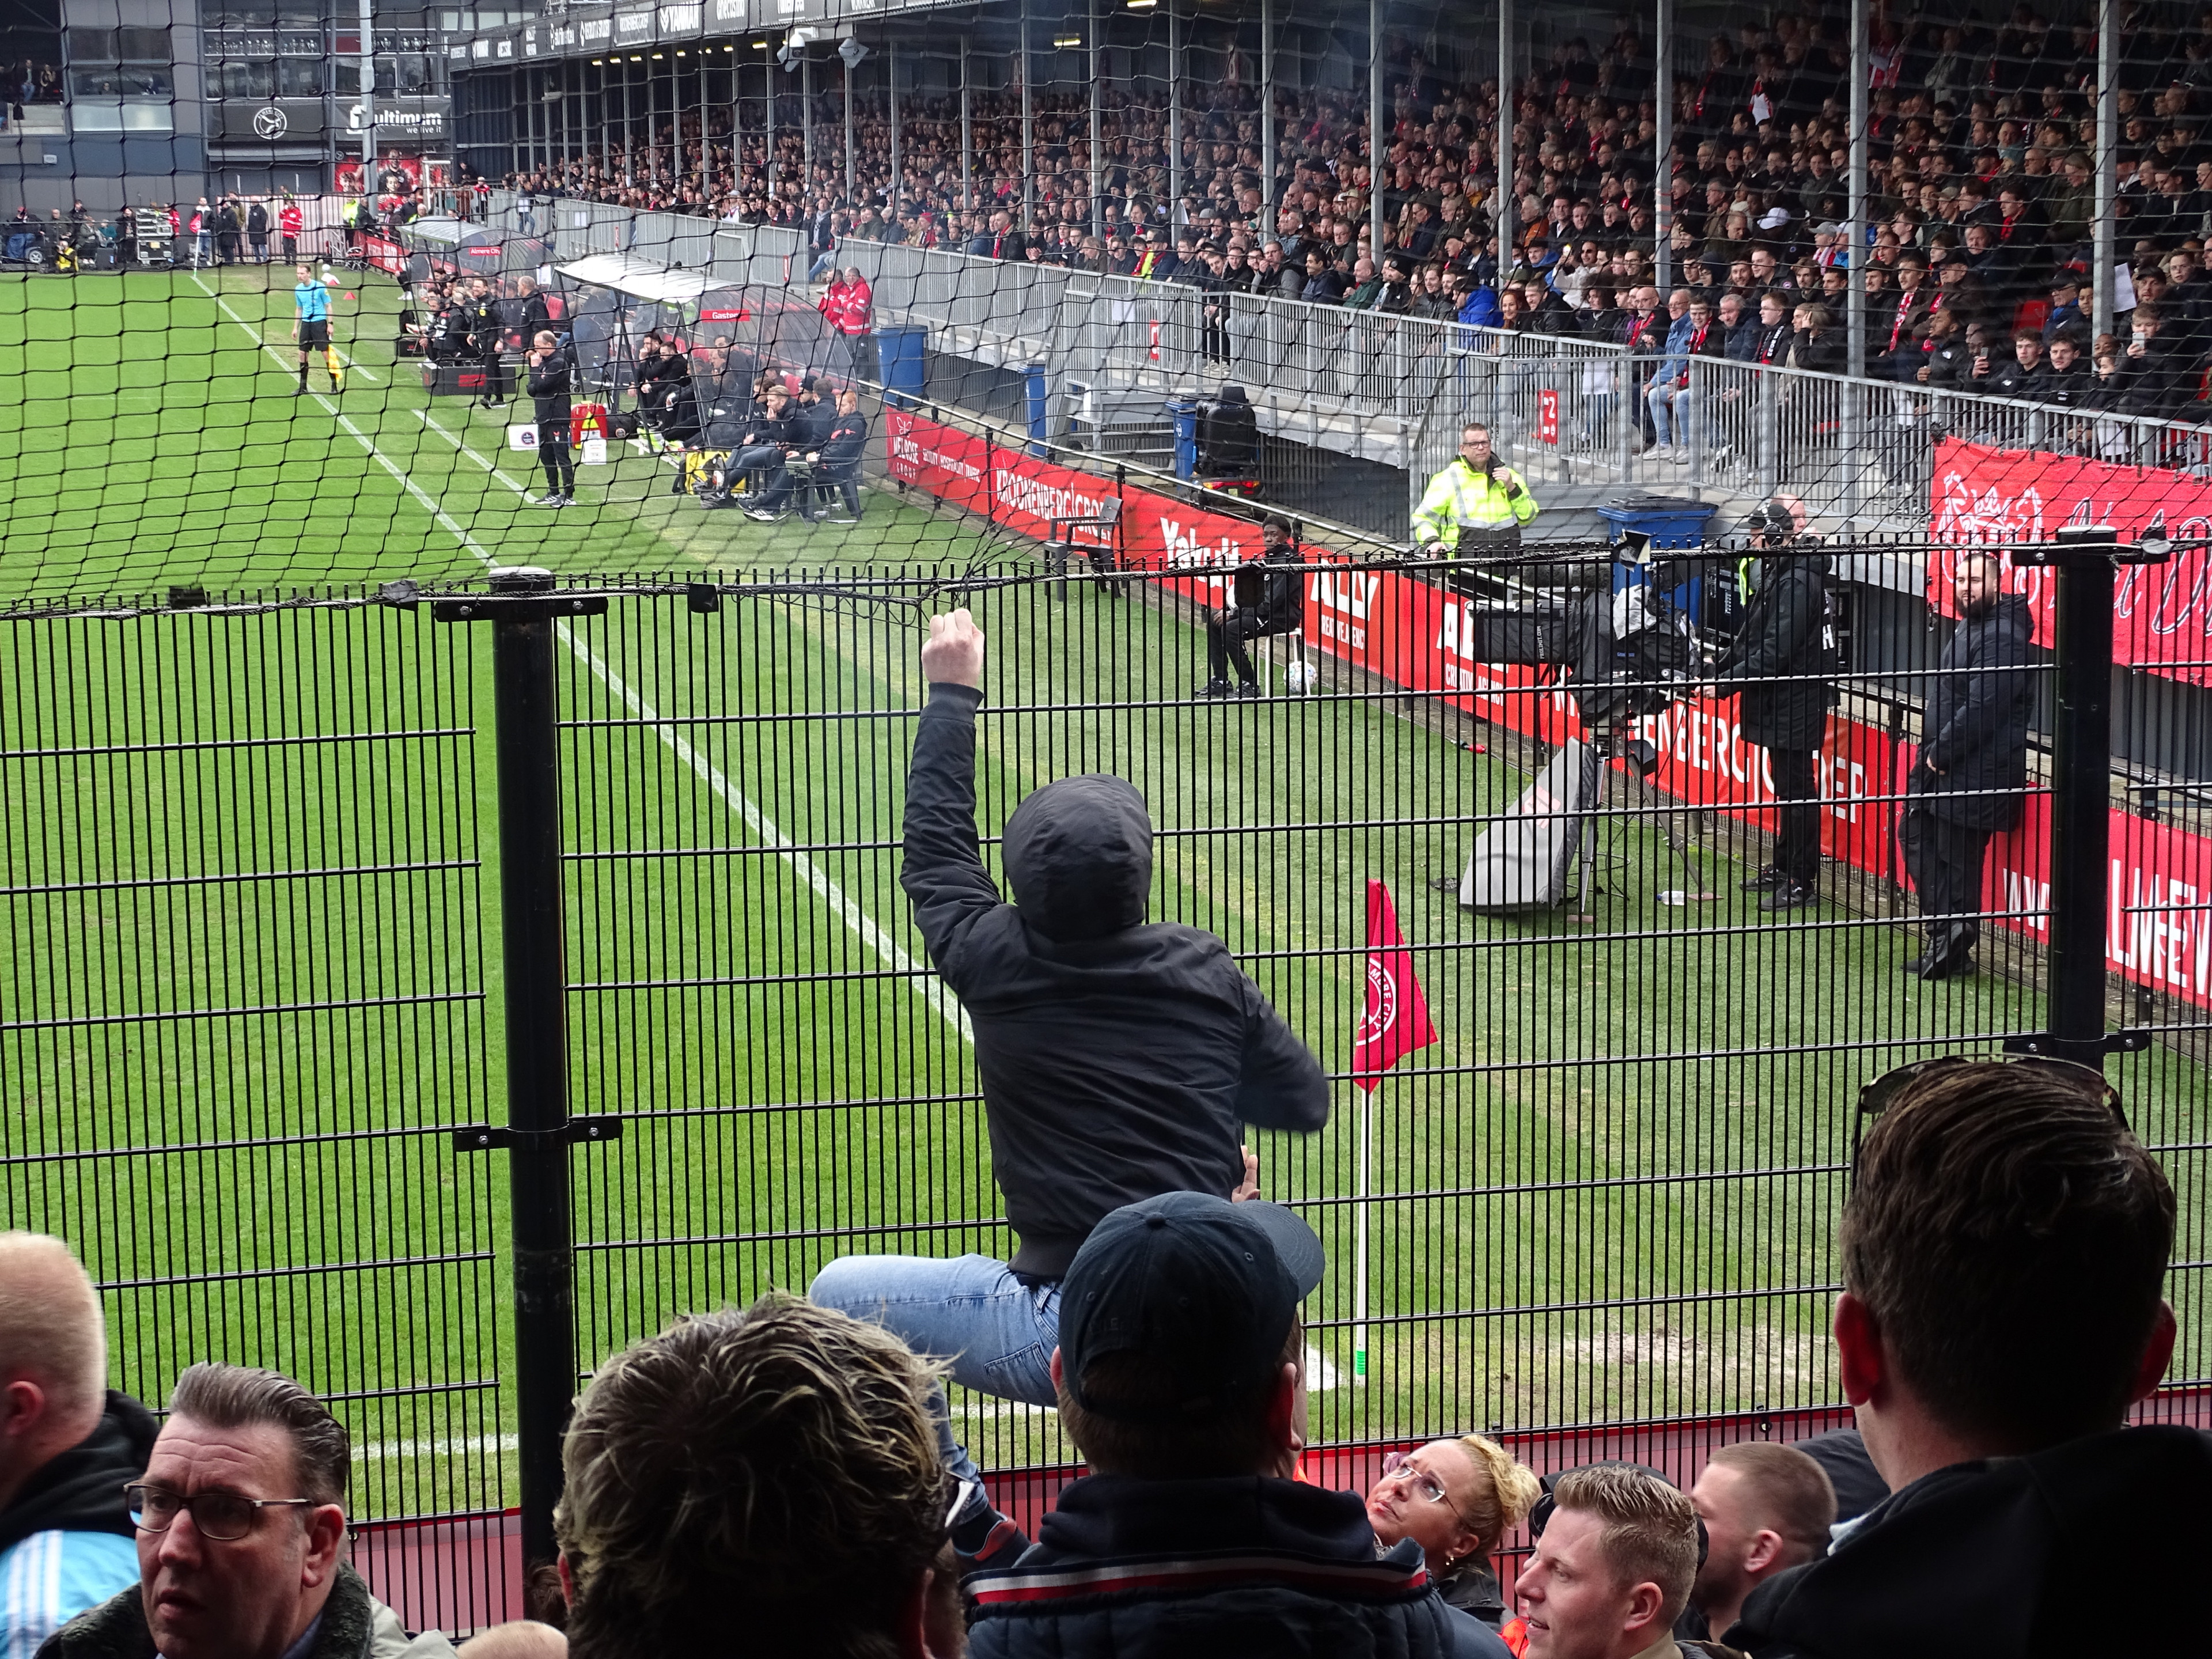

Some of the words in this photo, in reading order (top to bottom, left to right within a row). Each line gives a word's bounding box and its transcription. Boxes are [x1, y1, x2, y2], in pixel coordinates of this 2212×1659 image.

[669, 1, 699, 32] YANMAR
[375, 110, 441, 126] ultimum
[893, 437, 919, 465] MELROSE
[923, 448, 938, 465] SECURITY
[940, 454, 964, 475] HOSPITALITY
[965, 464, 980, 483] TRAFFIC
[1310, 559, 1379, 622] ALLY
